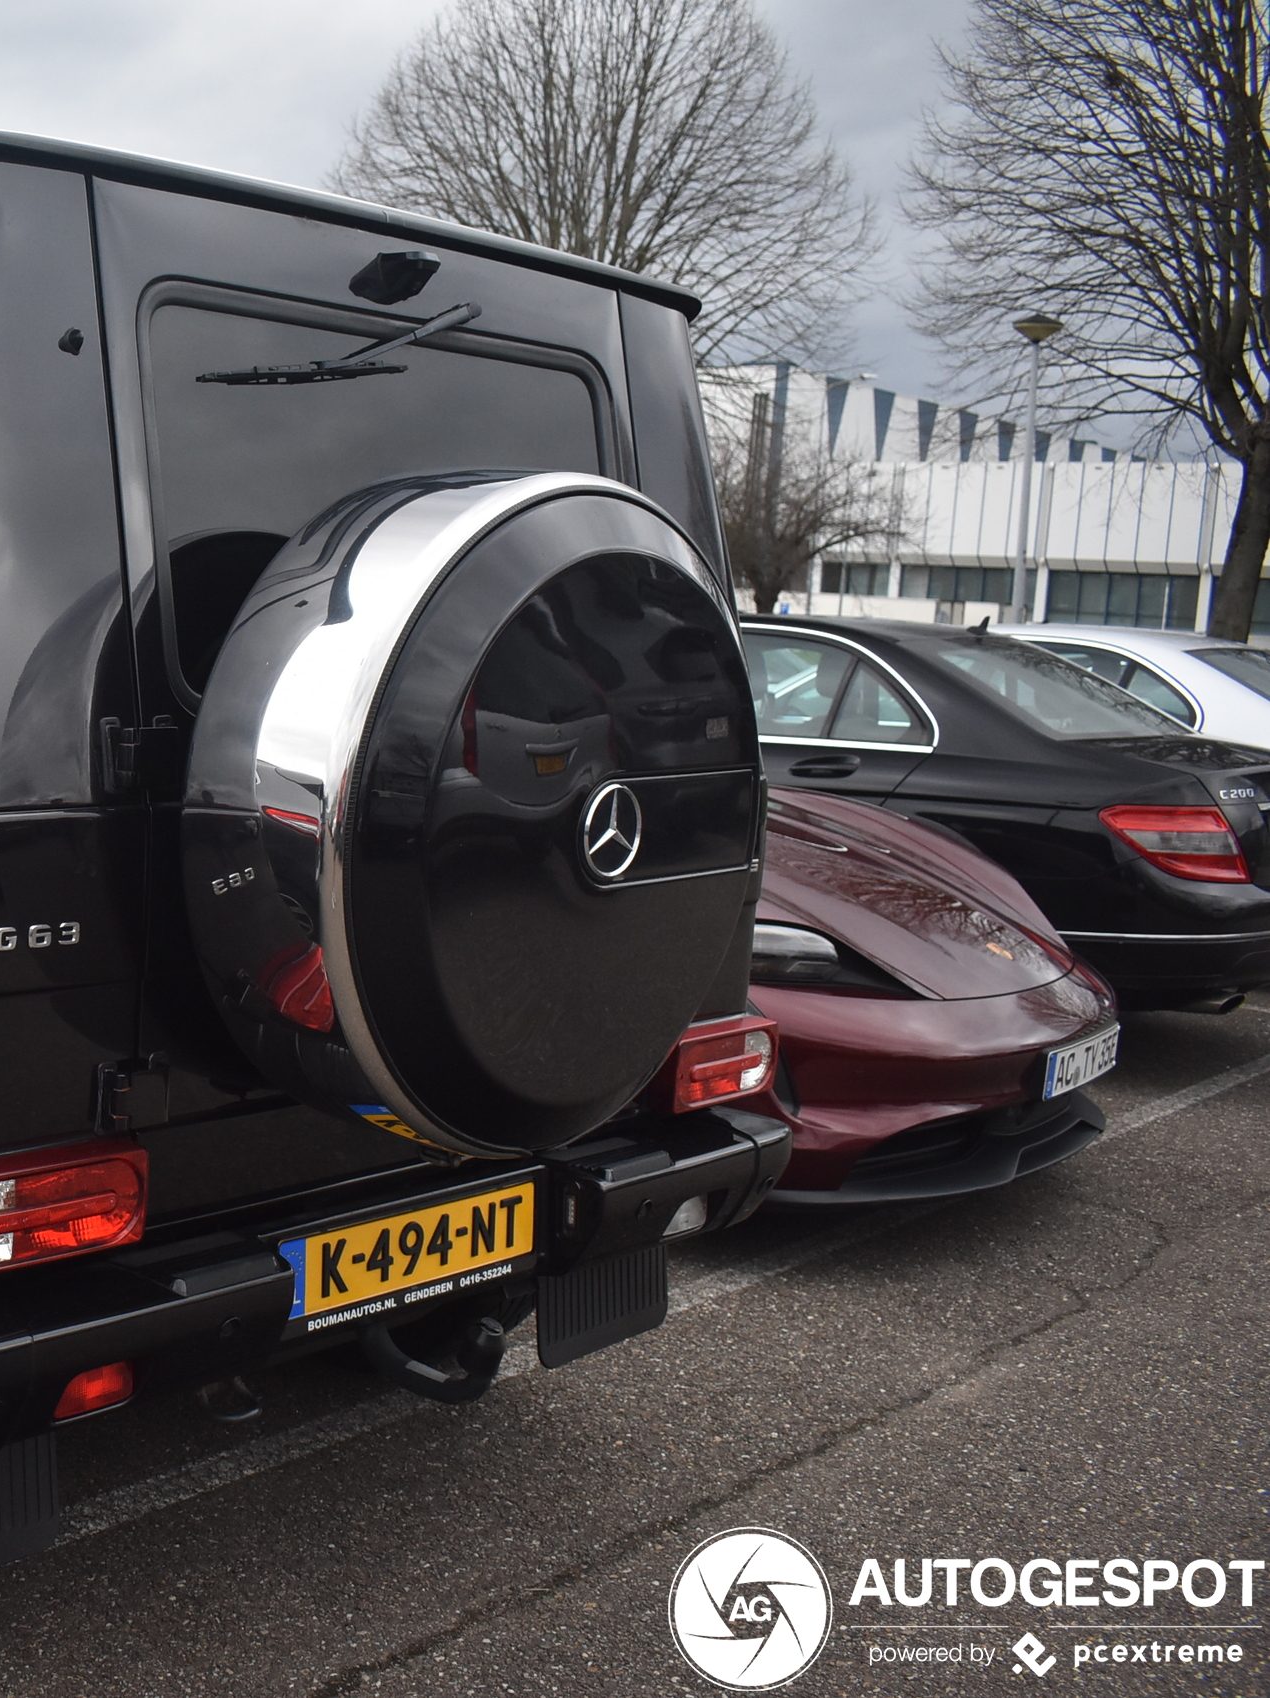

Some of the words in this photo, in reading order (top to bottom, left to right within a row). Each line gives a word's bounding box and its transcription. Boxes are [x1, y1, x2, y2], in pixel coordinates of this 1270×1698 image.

[1055, 1052, 1076, 1091] AC
[1083, 1041, 1100, 1079] TY
[321, 1194, 523, 1299] K-494-NT
[307, 1297, 398, 1332] BOUMANAUTOS.NL
[403, 1280, 454, 1304] GENDEREN
[459, 1263, 513, 1288] 0416-352244
